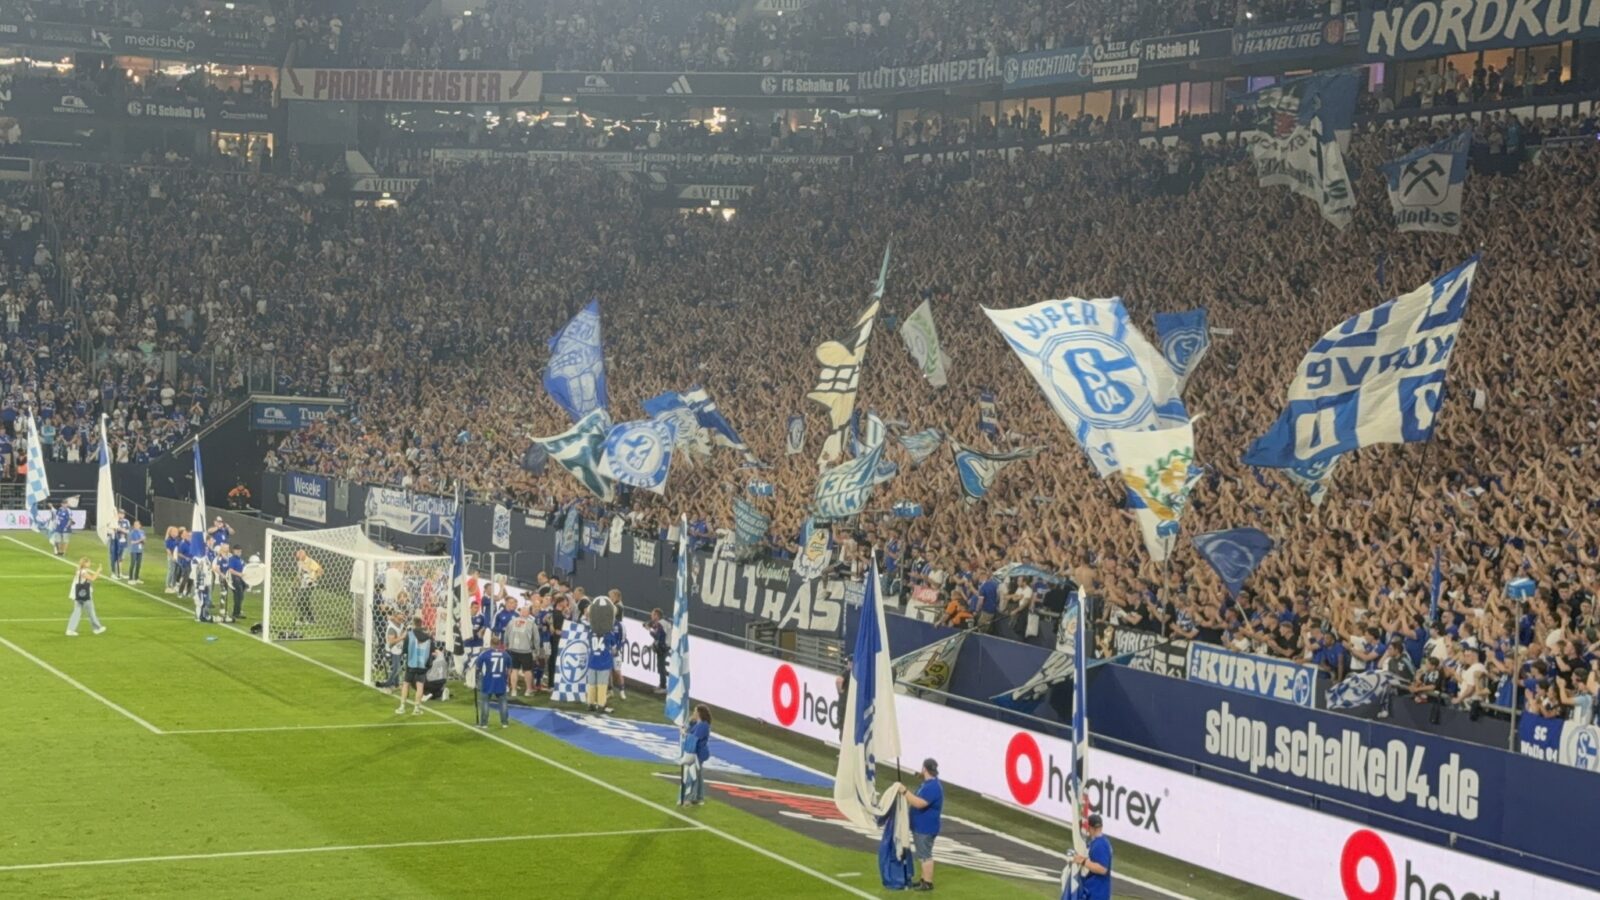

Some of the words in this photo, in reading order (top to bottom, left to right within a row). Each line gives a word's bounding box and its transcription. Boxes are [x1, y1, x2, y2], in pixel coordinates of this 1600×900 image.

[1145, 43, 1156, 61] FC
[1156, 41, 1188, 59] Schalke
[1188, 39, 1200, 56] 04
[1243, 32, 1322, 54] HAMBURG
[920, 56, 1003, 85] ENNEPETAL
[1093, 63, 1137, 77] KEVELAER
[313, 70, 502, 101] PROBLEMFENSTER
[782, 78, 798, 92] FC
[800, 78, 834, 93] Schalke
[835, 78, 849, 92] 04
[145, 103, 157, 116] FC
[158, 105, 193, 118] Schalke
[193, 106, 206, 120] 04
[1014, 301, 1100, 340] SUPER
[293, 476, 321, 498] Weseke
[490, 657, 504, 673] 71
[1199, 650, 1295, 700] KURVE
[1205, 701, 1480, 821] shop.schalke04.de
